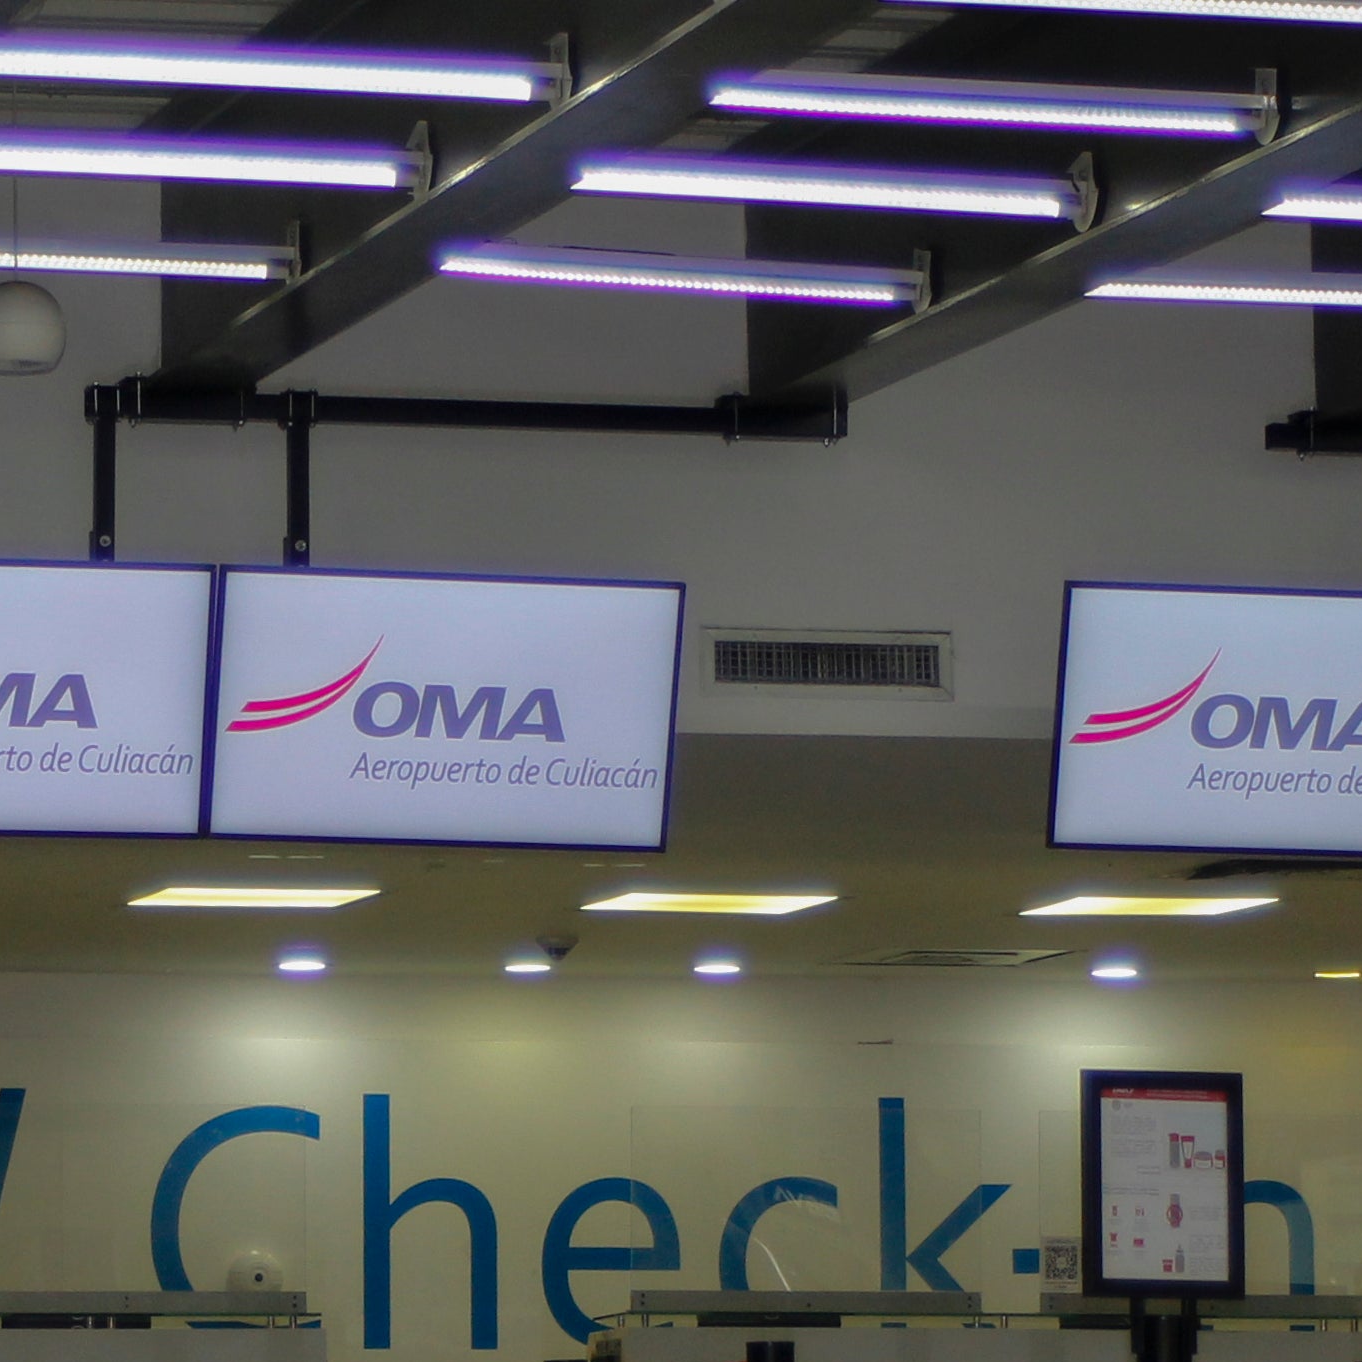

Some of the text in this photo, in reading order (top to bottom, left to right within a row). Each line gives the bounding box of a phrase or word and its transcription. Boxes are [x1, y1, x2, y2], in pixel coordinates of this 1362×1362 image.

[353, 682, 565, 742] OMA
[40, 743, 72, 772] de
[79, 744, 194, 774] Culiacán
[350, 752, 657, 789] Aeropuerto de Culiacán
[1187, 764, 1331, 799] Aeropuerto
